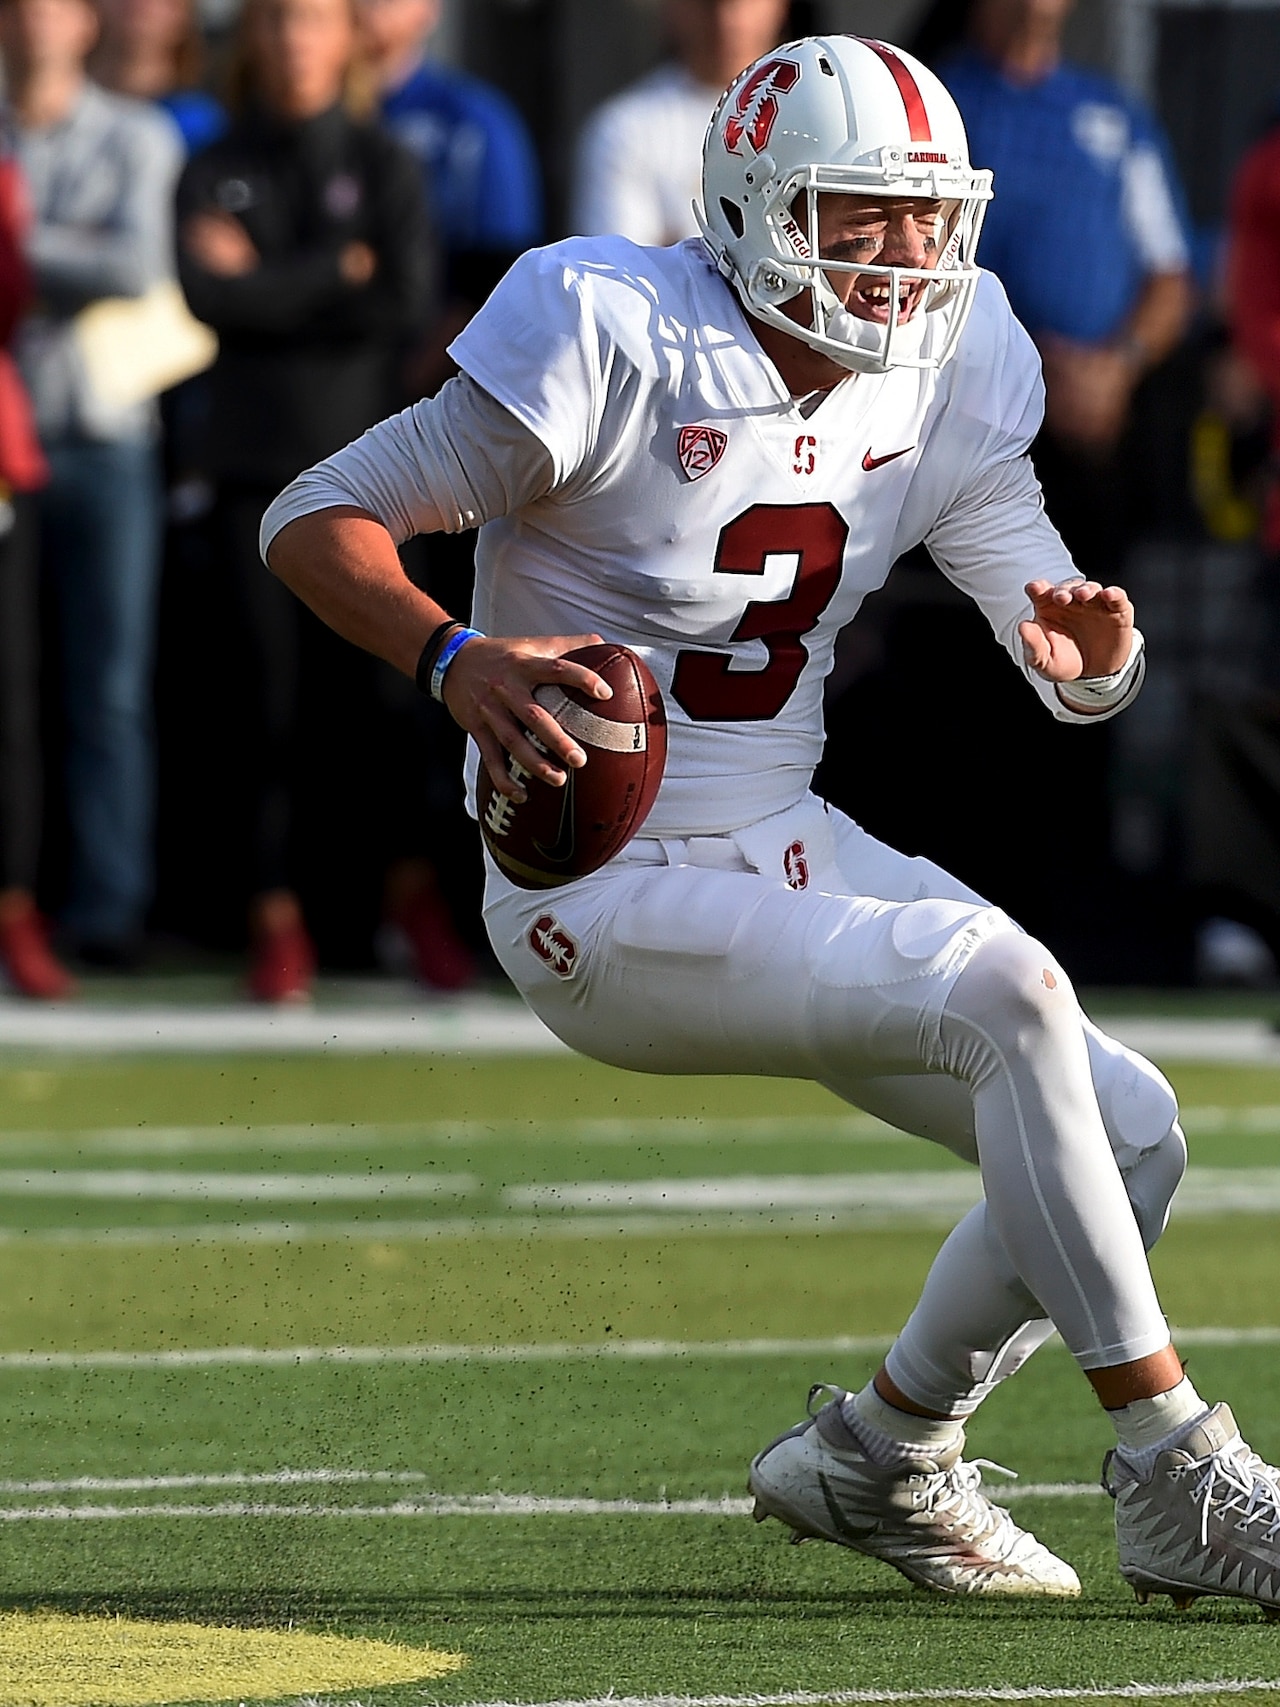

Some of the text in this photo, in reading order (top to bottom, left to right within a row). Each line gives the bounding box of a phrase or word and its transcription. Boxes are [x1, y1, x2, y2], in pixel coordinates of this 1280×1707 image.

[781, 218, 811, 259] Ridd
[680, 428, 725, 463] PAC
[684, 449, 711, 471] 12
[669, 501, 851, 725] 3
